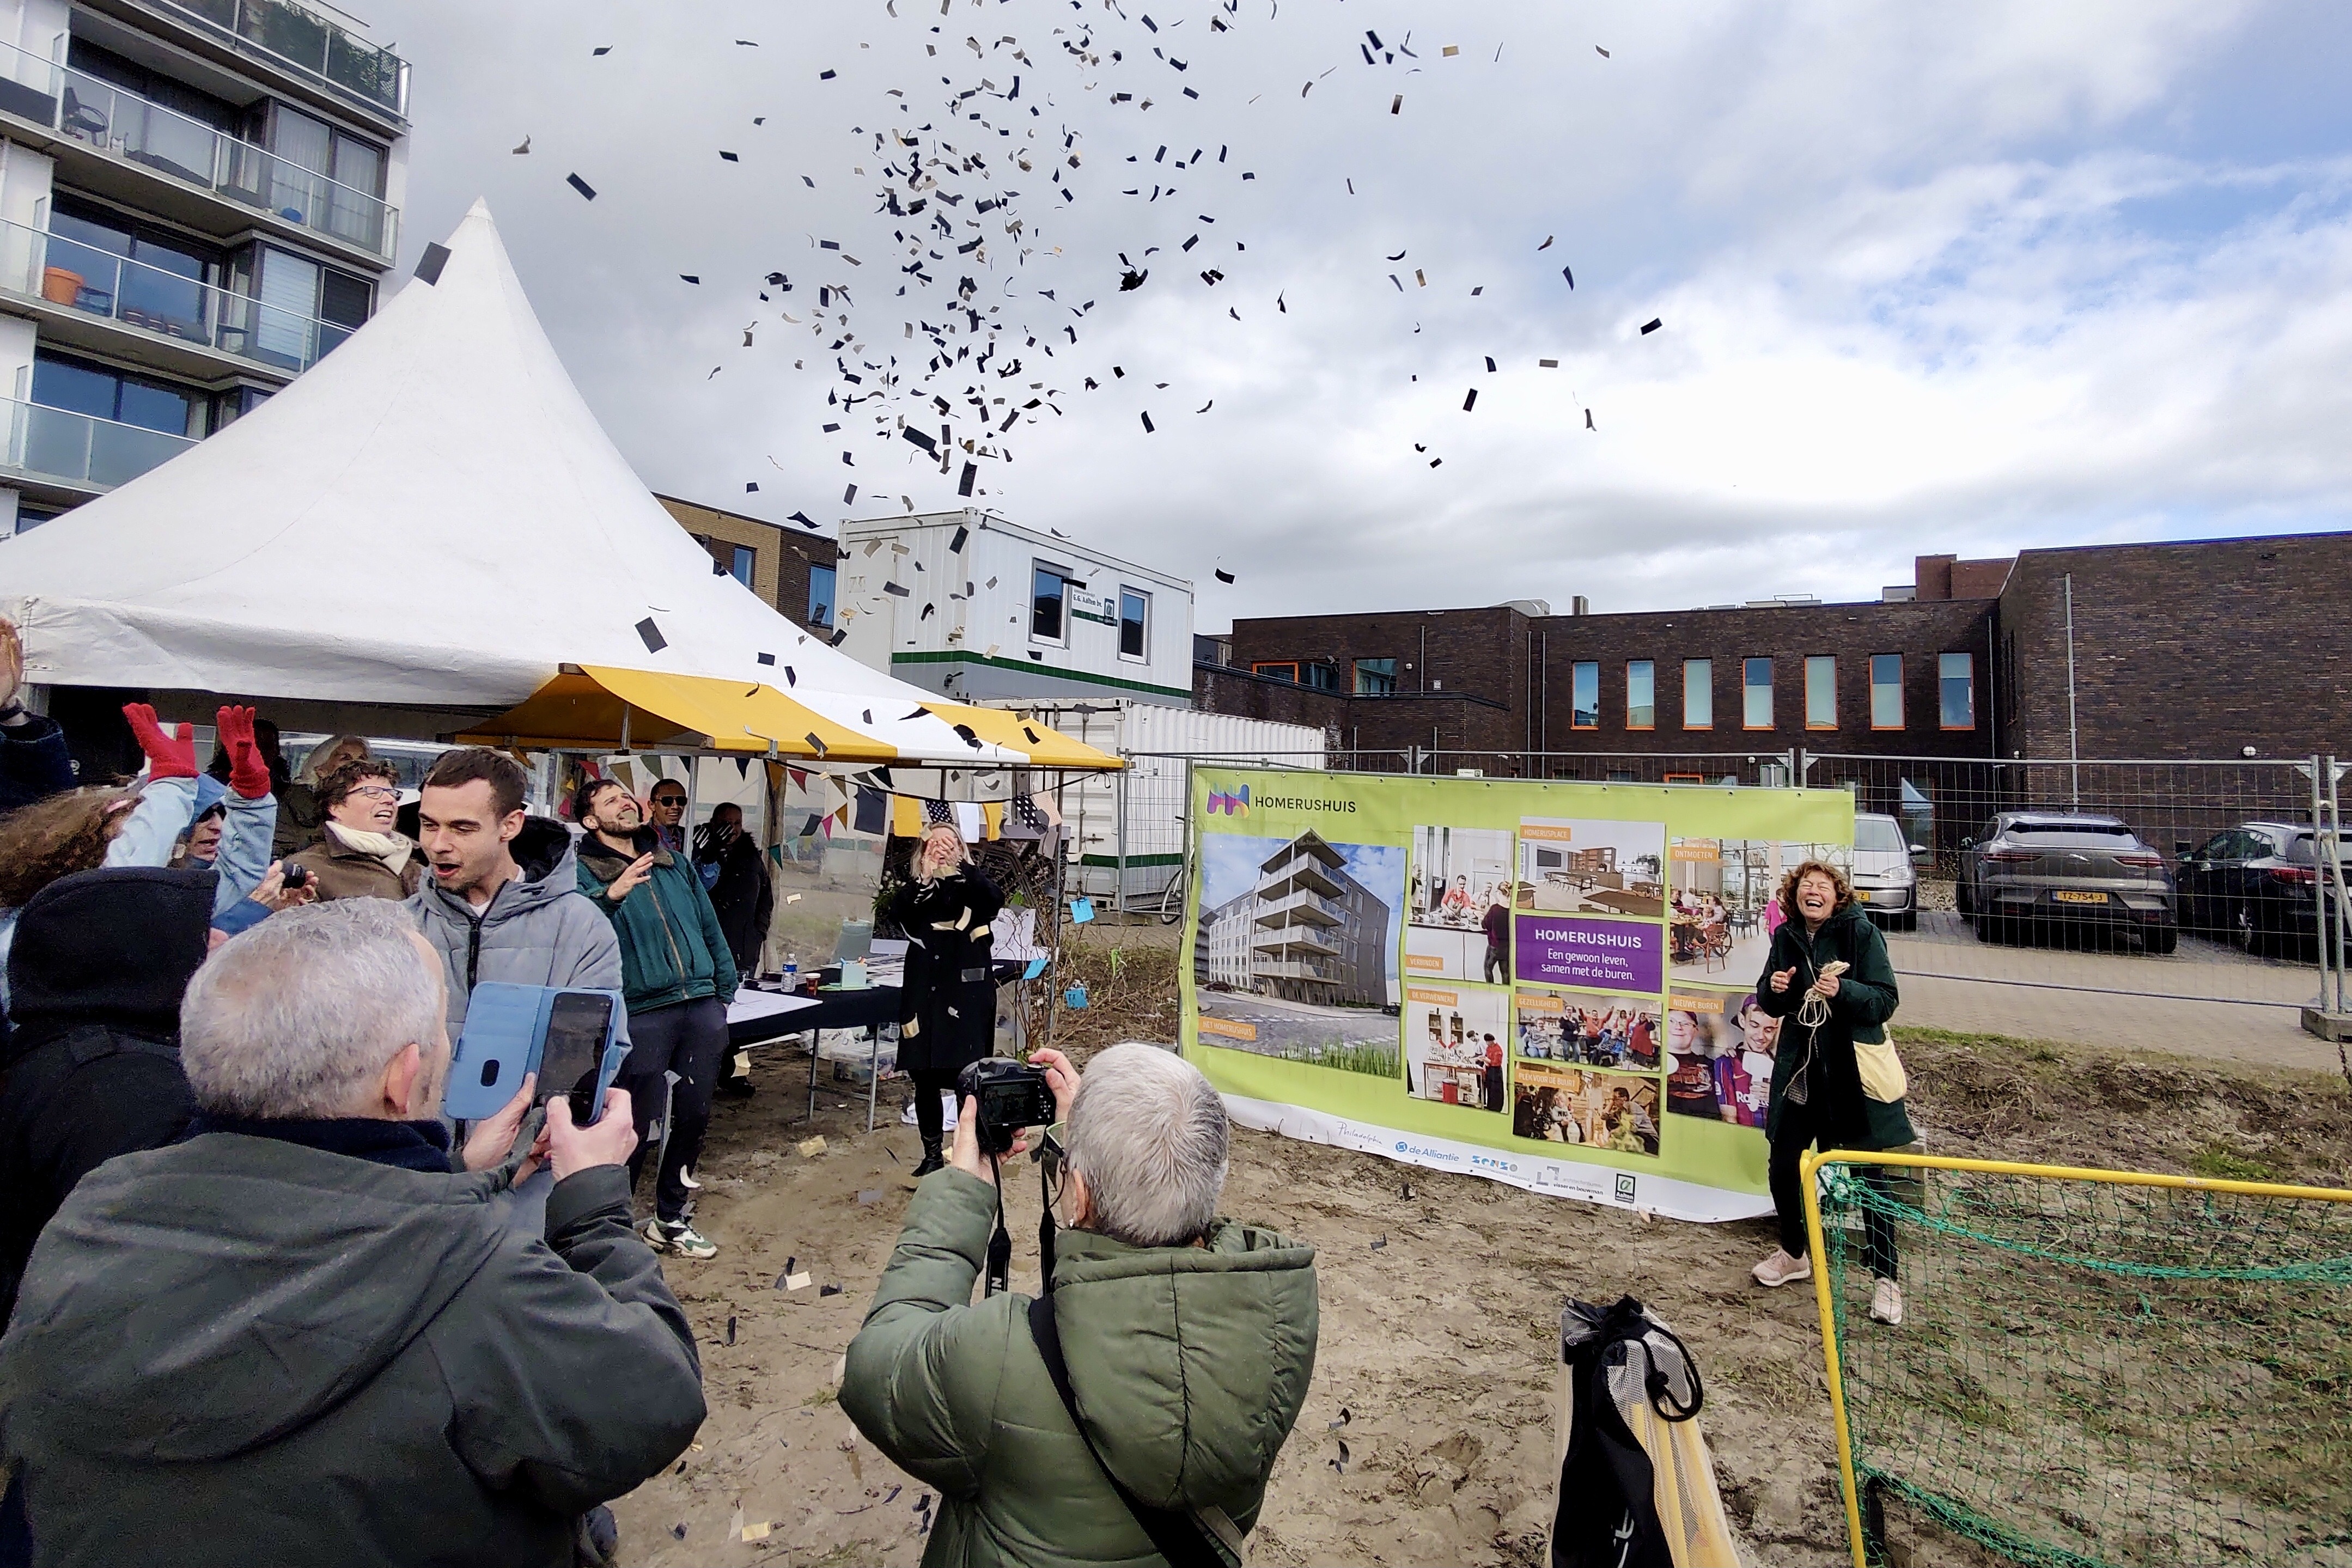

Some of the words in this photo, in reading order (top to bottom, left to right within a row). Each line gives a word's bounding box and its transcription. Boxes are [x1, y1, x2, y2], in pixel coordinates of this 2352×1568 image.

[1255, 796, 1356, 813] HOMERUSHUIS
[1525, 829, 1567, 839] HOMERUSPLACE
[1675, 850, 1713, 859] ONTMOETEN
[1535, 929, 1642, 948] HOMERUSHUIS
[1410, 958, 1439, 967] VERBINDEN
[1548, 948, 1563, 960] Een
[1565, 953, 1600, 964] gewoon
[1602, 953, 1629, 967] leven,
[1541, 963, 1570, 975] samen
[1572, 967, 1590, 977] met
[1592, 966, 1603, 978] de
[1605, 969, 1635, 981] buren.
[1519, 998, 1558, 1008] GEZELLIGHEID
[1673, 998, 1697, 1008] NIEUWE
[1698, 1001, 1719, 1010] BUREN
[1214, 1023, 1253, 1036] HOMERUSHUIS
[1519, 1073, 1532, 1081] PLEK
[1533, 1075, 1547, 1083] VOOR
[1557, 1077, 1575, 1087] BUURT
[1336, 1121, 1382, 1145] Philadelphia
[1576, 1186, 1603, 1195] bouwman
